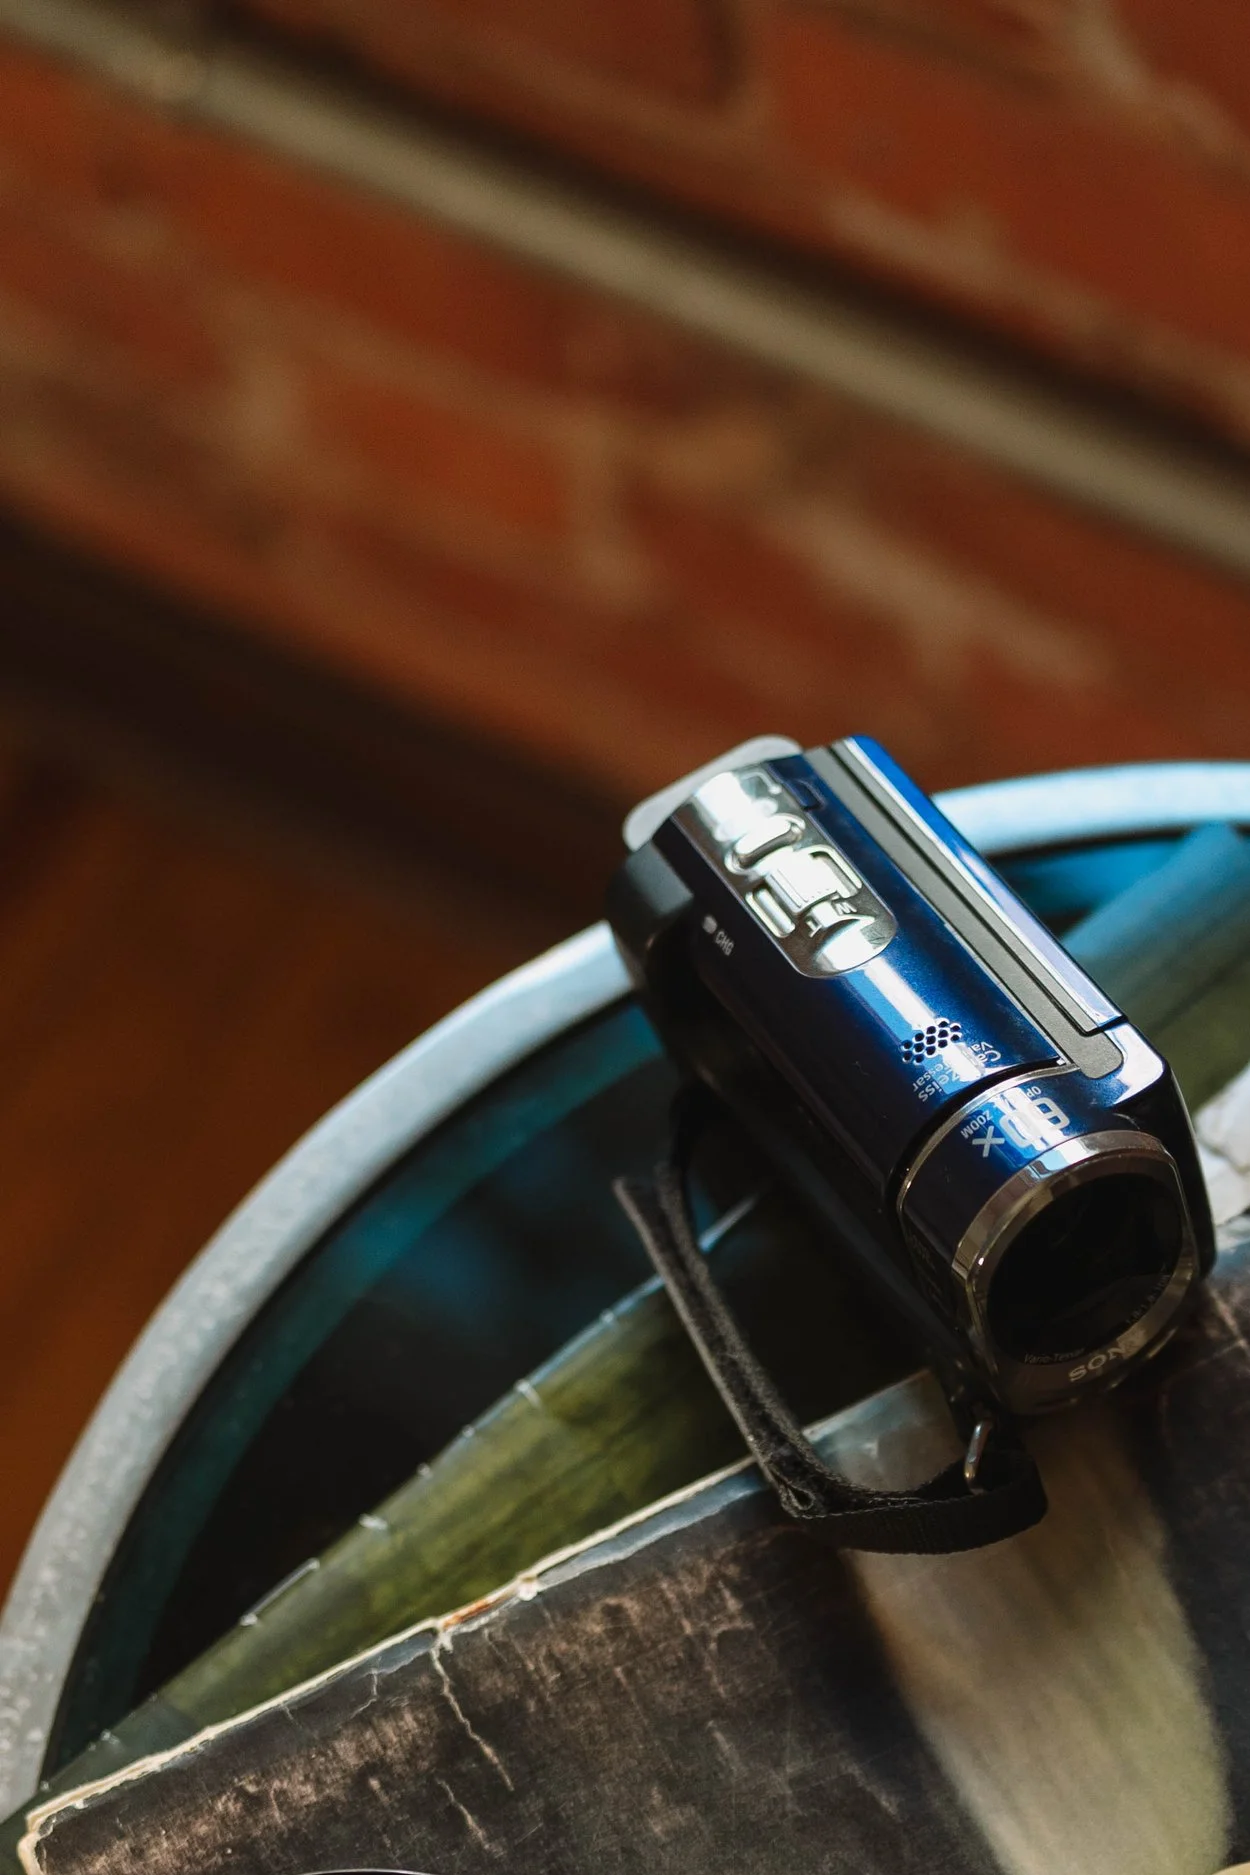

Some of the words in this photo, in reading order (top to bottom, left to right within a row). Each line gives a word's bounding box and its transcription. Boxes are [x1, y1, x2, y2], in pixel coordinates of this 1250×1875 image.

[714, 930, 735, 957] CHG
[918, 1070, 962, 1102] Zeiss
[960, 1109, 994, 1140] ZOOM
